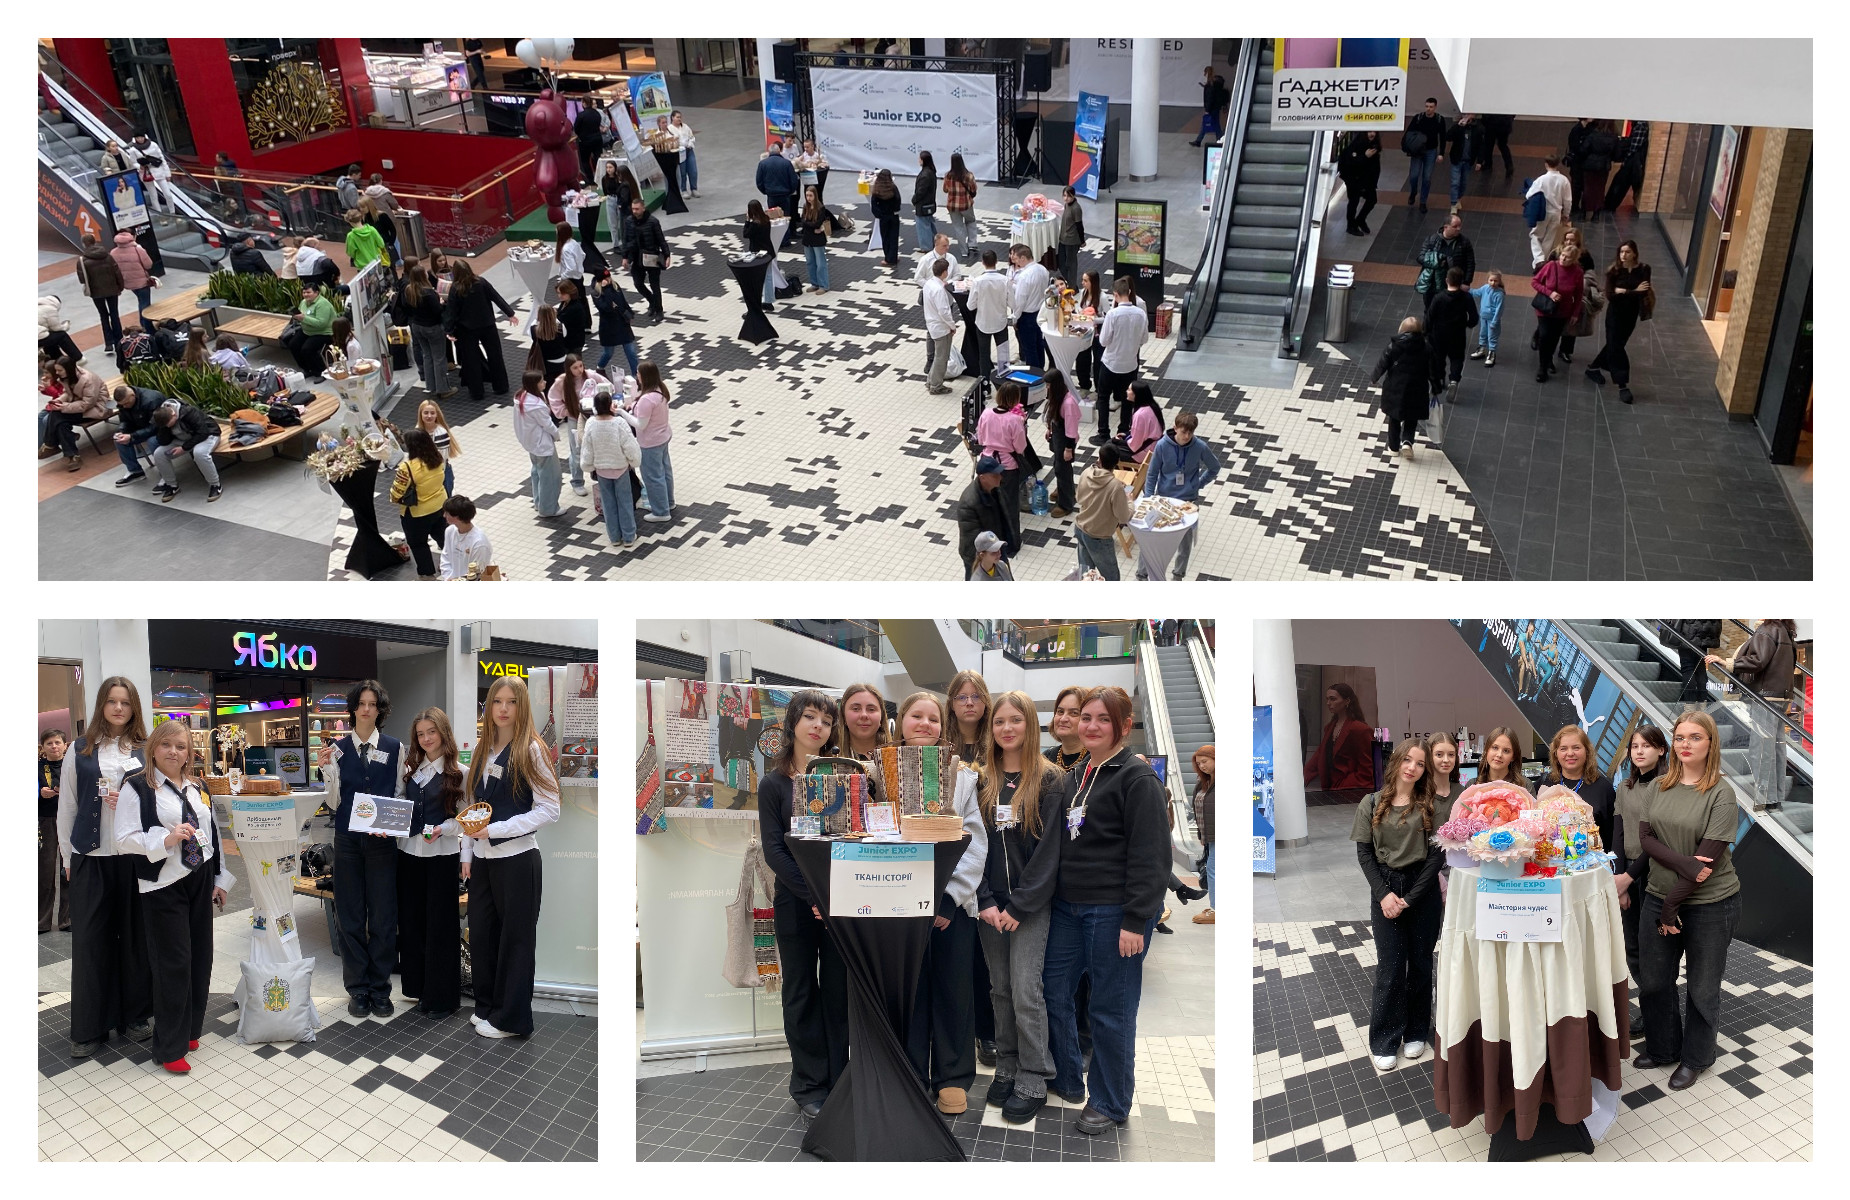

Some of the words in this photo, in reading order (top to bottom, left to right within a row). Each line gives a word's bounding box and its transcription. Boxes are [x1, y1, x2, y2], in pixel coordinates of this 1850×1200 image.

[1098, 38, 1184, 51] RESED
[1279, 78, 1400, 94] ҐАДЖЕТИ?
[1278, 97, 1291, 108] В
[1297, 96, 1398, 108] YABLUKA!
[863, 109, 903, 121] Junior
[906, 112, 942, 123] EXPO
[42, 175, 73, 204] БРЕНДИ
[38, 196, 69, 228] АГАЗИНІ
[80, 212, 94, 232] 2
[1140, 266, 1160, 274] FORUM
[232, 632, 317, 670] Ябко
[480, 660, 533, 678] YABL
[1404, 732, 1476, 740] RESVD
[858, 846, 889, 854] Junior
[883, 873, 912, 881] ІСТОРІЇ
[858, 905, 871, 914] citi
[918, 901, 930, 909] 17
[1497, 931, 1507, 939] citi
